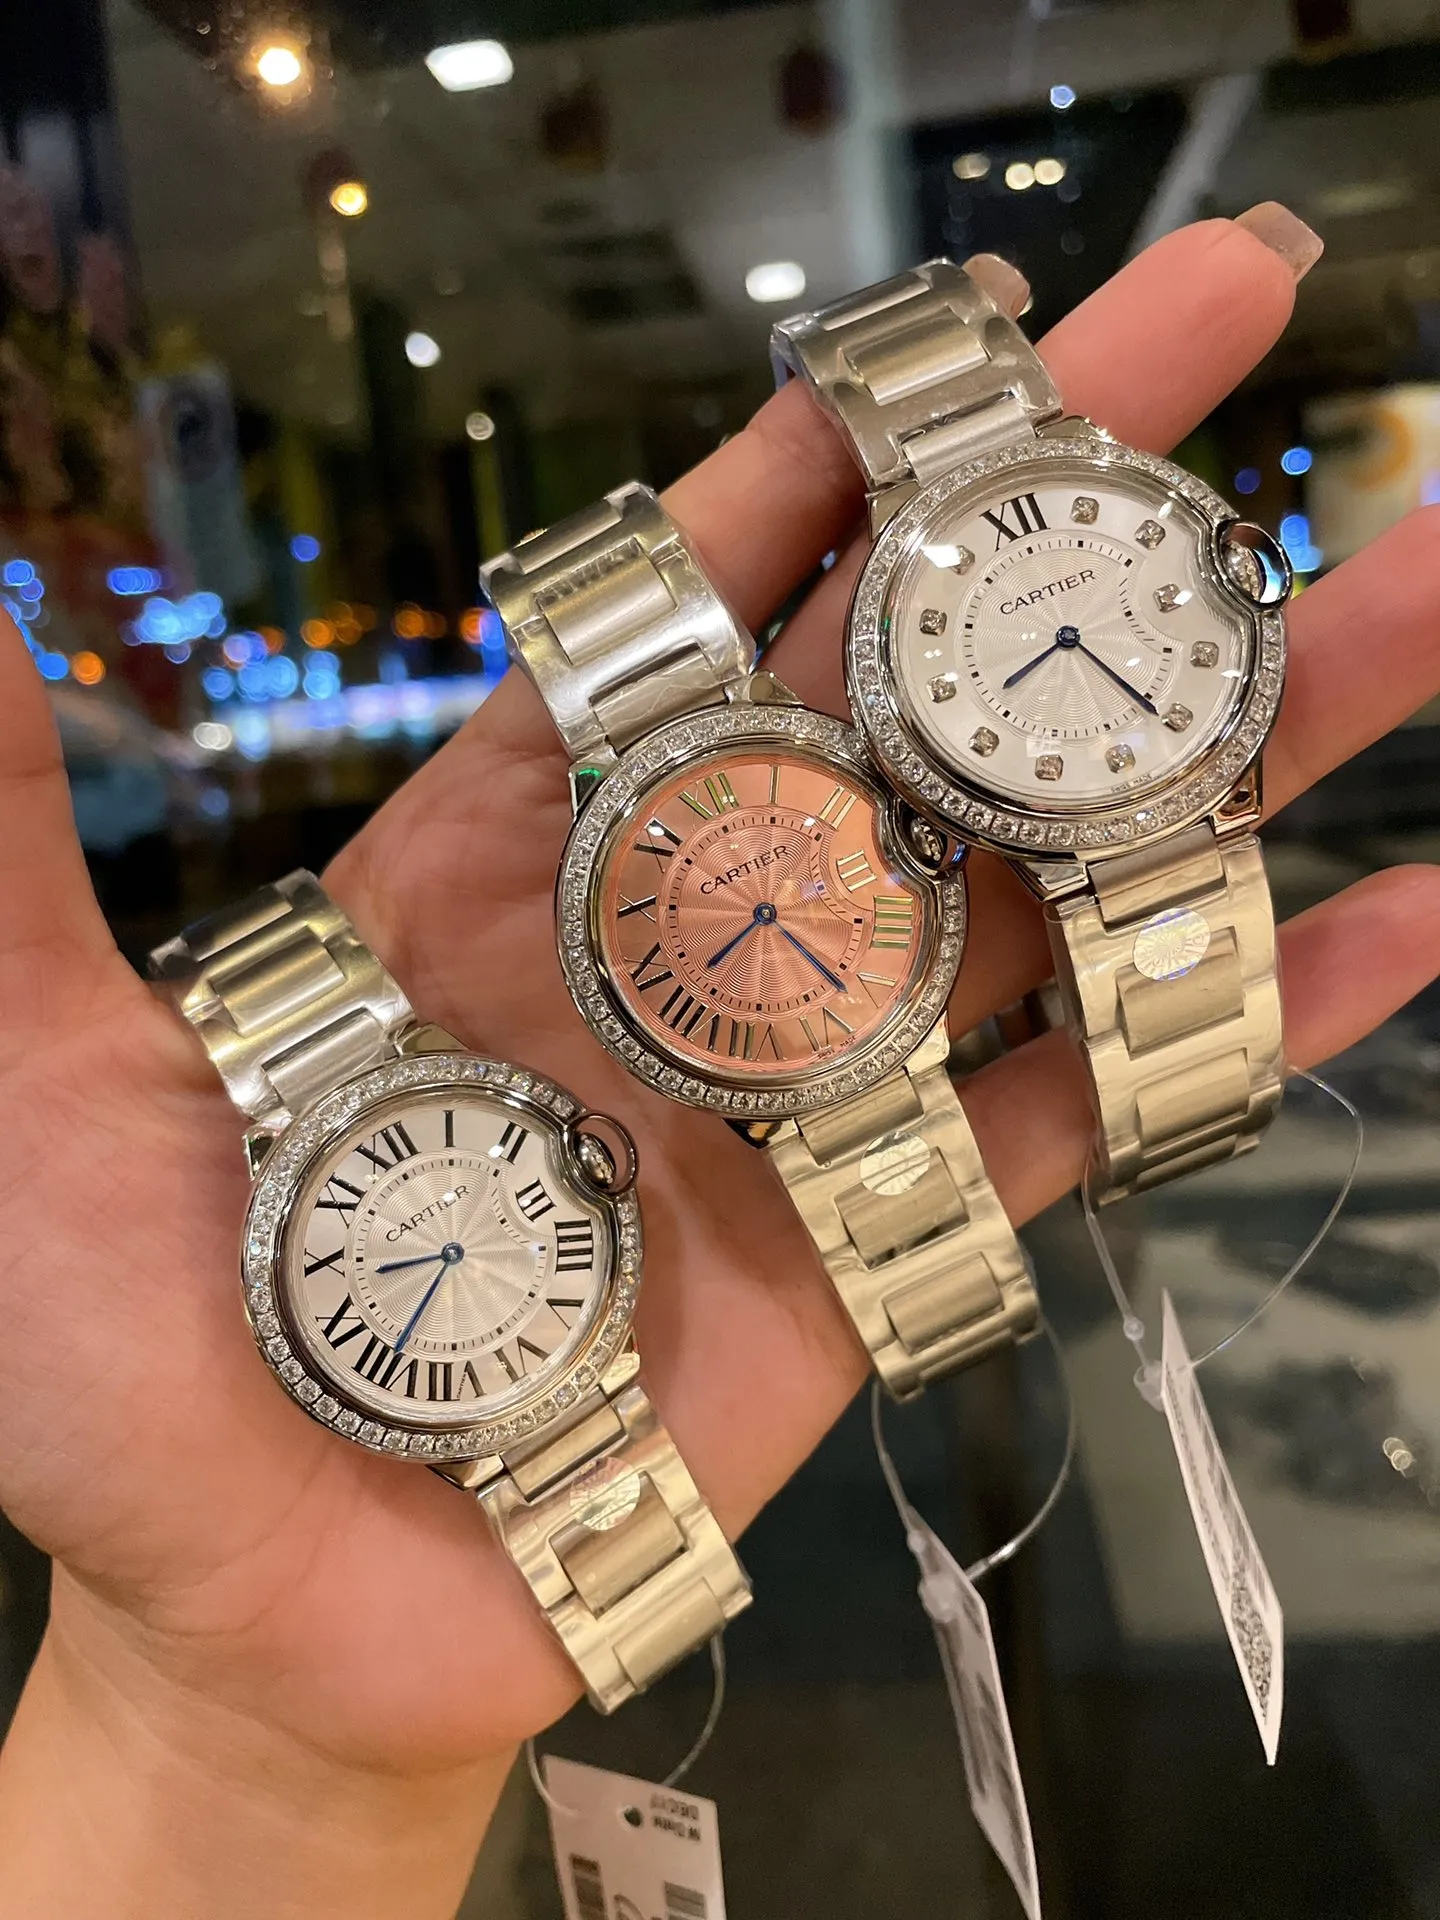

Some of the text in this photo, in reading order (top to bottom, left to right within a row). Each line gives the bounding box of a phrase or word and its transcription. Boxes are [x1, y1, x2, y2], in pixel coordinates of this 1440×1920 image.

[979, 492, 1051, 553] XII
[999, 568, 1096, 616] CARTIER
[677, 771, 742, 827] XII
[767, 764, 782, 805] I
[816, 785, 858, 830] II
[632, 815, 684, 874] XI
[700, 843, 791, 897] CARTIER
[835, 850, 878, 893] III
[616, 891, 658, 923] X
[872, 894, 915, 951] IIII
[624, 942, 674, 993] IX
[856, 972, 898, 1008] V
[657, 984, 722, 1052] VIII
[730, 1018, 788, 1062] VII
[799, 1007, 857, 1053] VI
[353, 1120, 422, 1175] XII
[443, 1109, 456, 1148] I
[488, 1120, 530, 1165] II
[314, 1171, 367, 1228] XI
[515, 1177, 556, 1222] III
[303, 1245, 346, 1279] X
[554, 1218, 594, 1274] IIII
[315, 1292, 369, 1350] IX
[546, 1298, 585, 1330] V
[351, 1333, 419, 1400] VIII
[425, 1359, 488, 1402] VII
[495, 1335, 552, 1386] VI
